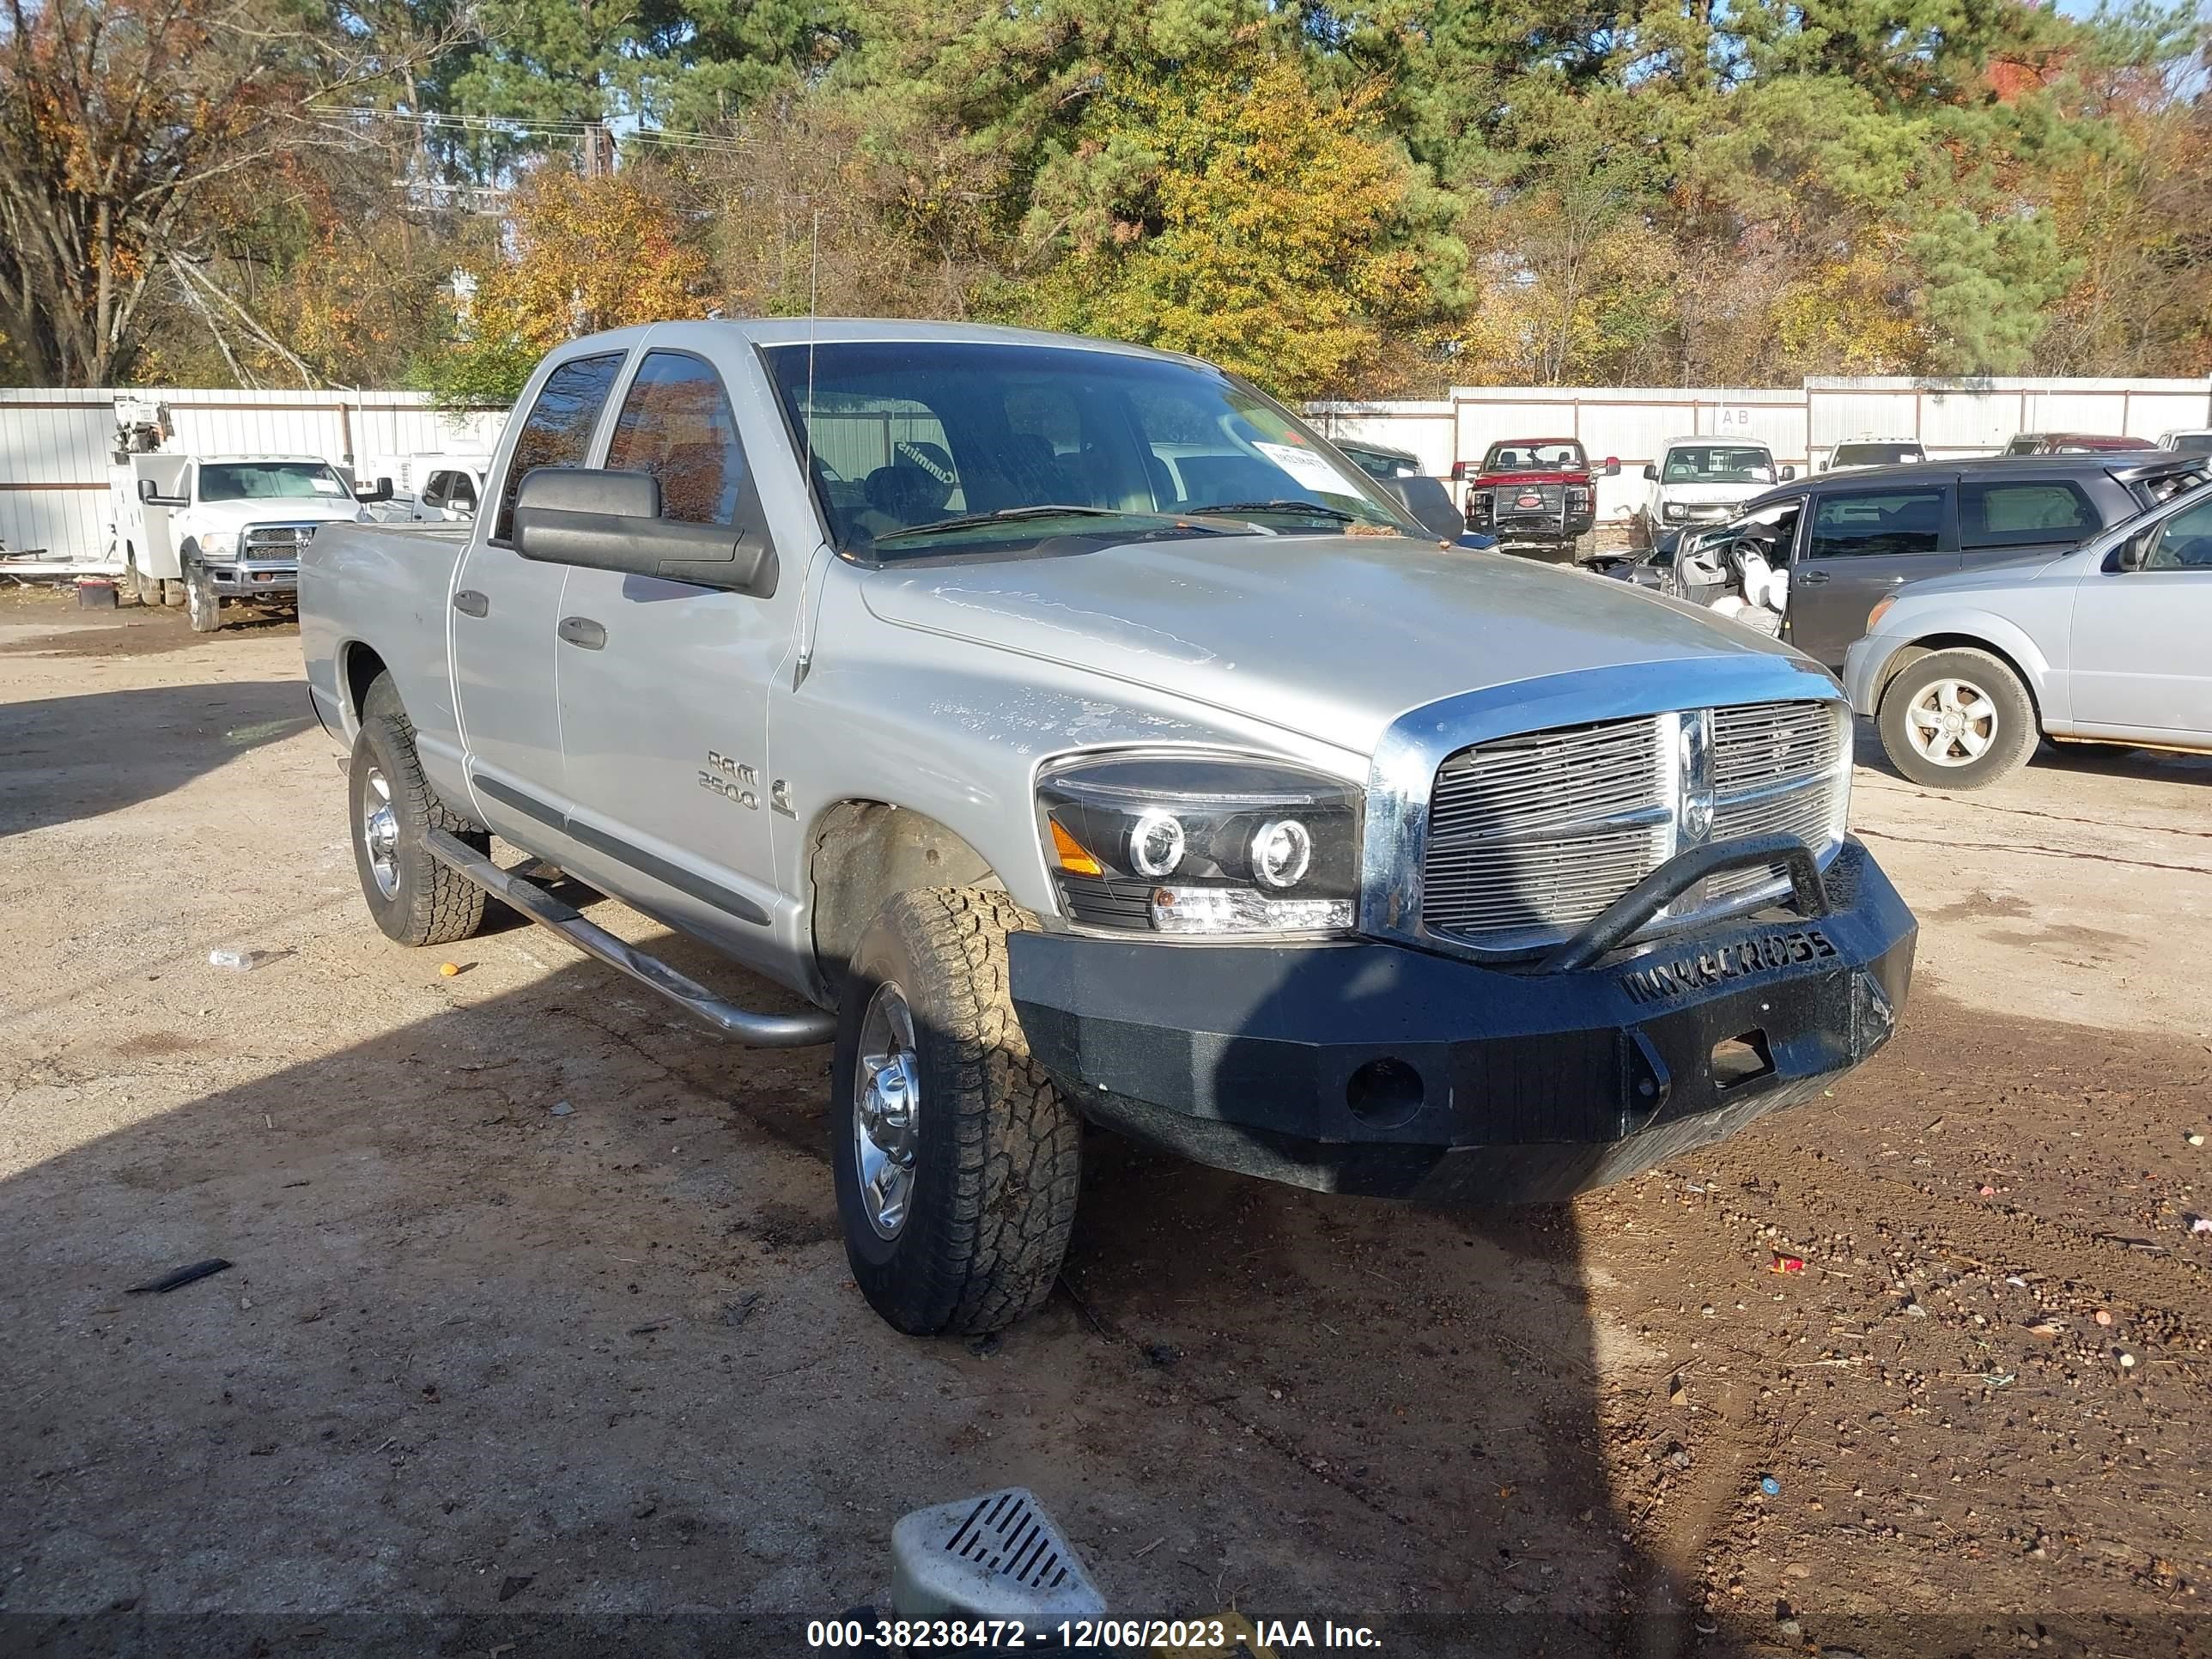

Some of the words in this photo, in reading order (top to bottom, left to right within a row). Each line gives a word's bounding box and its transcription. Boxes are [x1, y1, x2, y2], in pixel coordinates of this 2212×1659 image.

[1723, 410, 1733, 424] A
[1739, 410, 1748, 424] B
[708, 749, 758, 787] RAM
[698, 770, 760, 810] 2500
